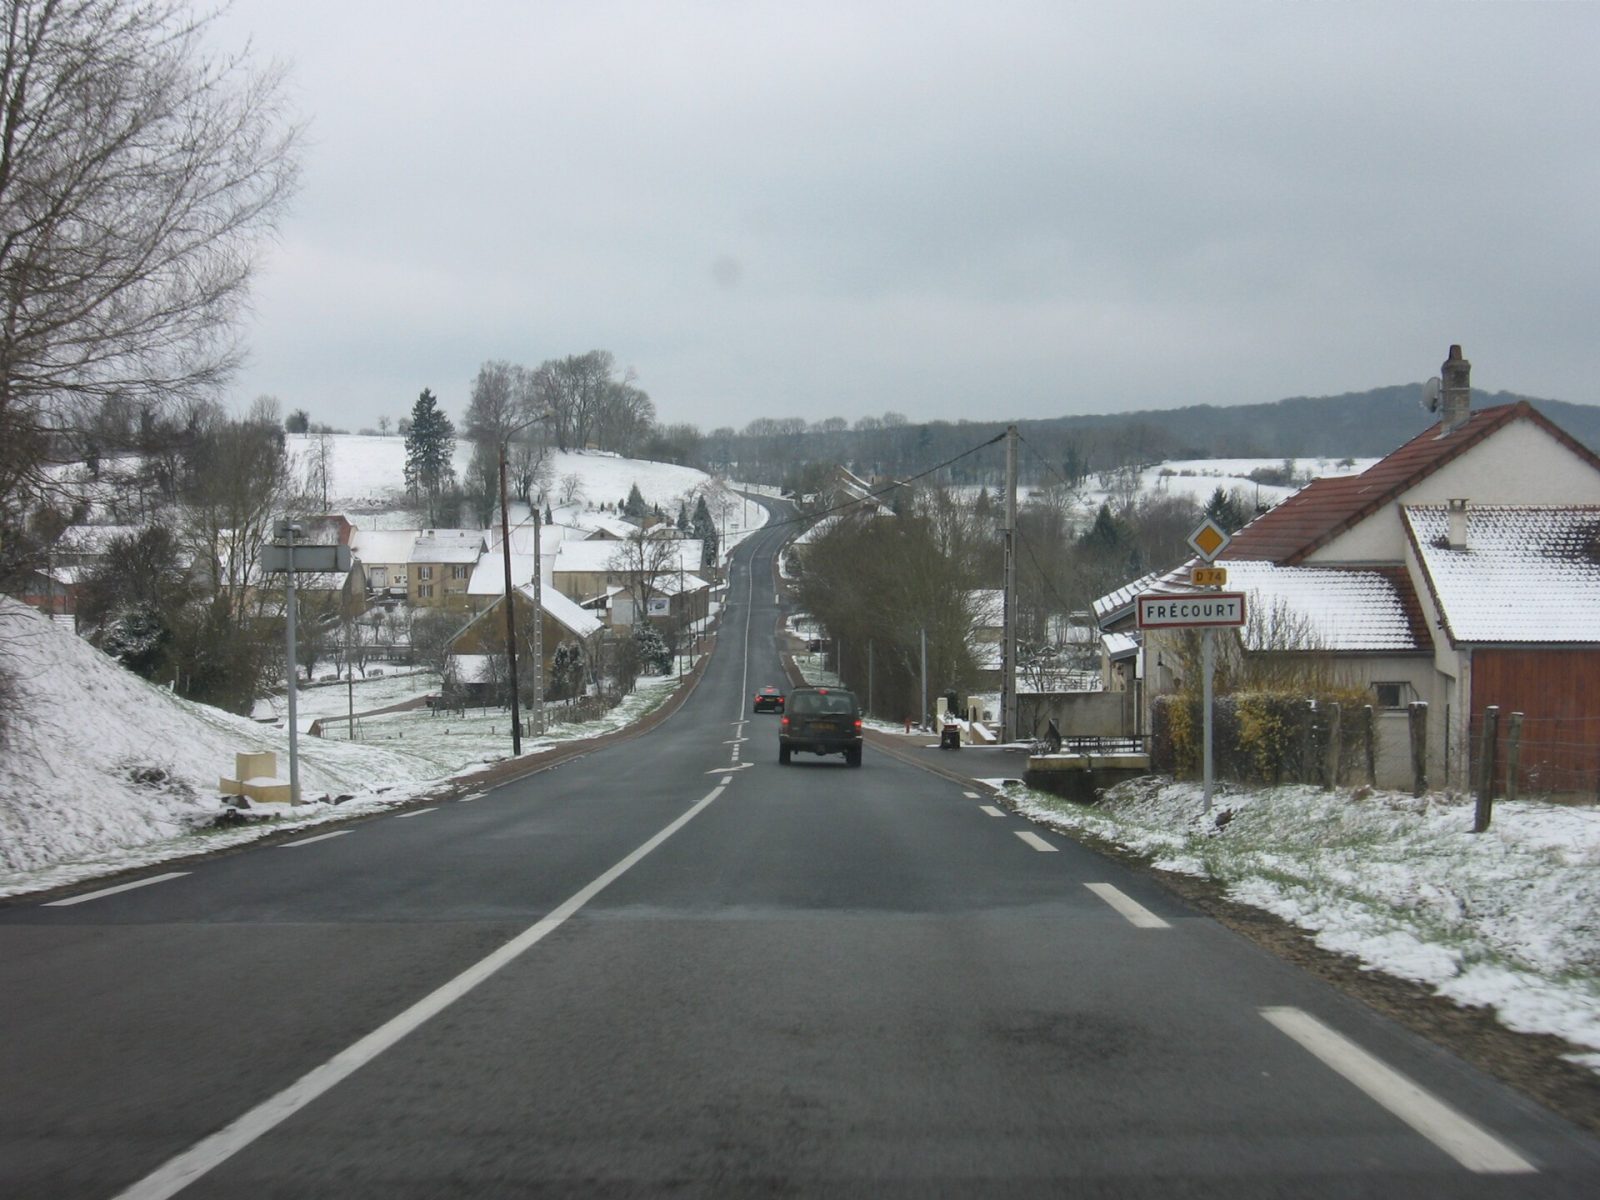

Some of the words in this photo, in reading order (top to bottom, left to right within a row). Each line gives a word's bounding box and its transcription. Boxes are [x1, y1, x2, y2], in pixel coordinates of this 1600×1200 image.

[1196, 571, 1204, 582] D
[1208, 571, 1222, 581] 74
[1147, 603, 1235, 618] FRÉCOURT
